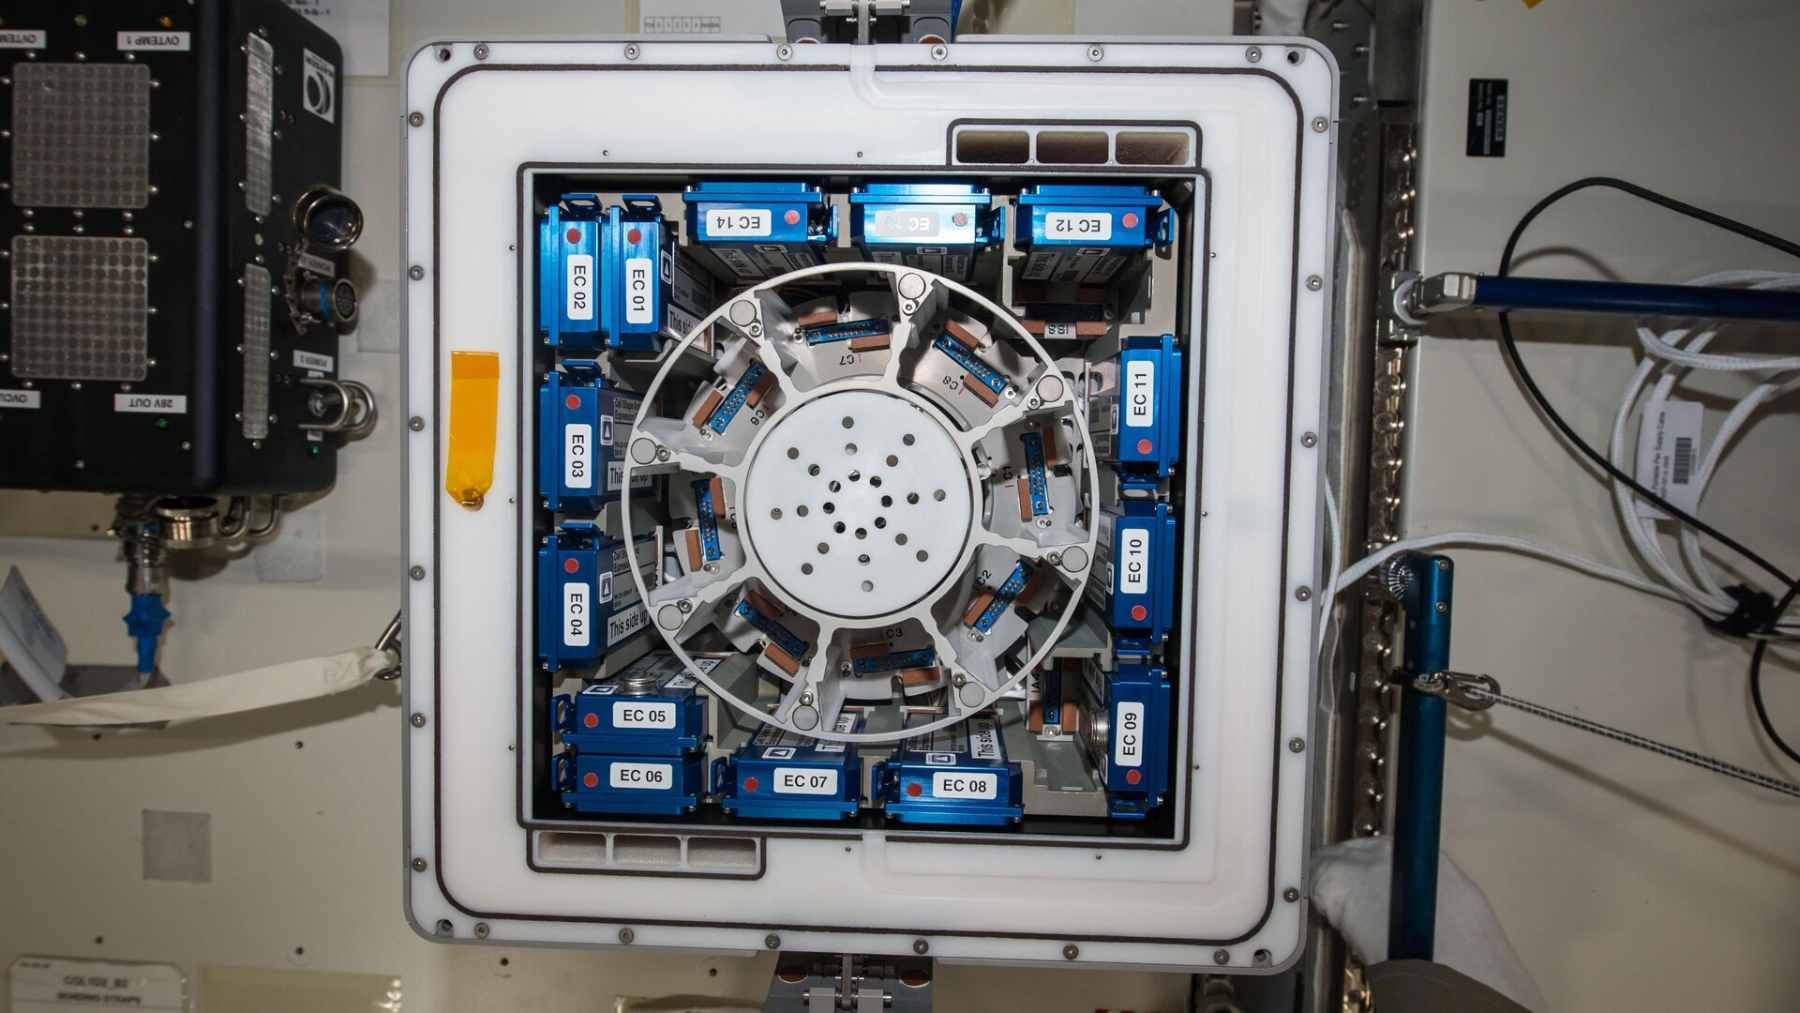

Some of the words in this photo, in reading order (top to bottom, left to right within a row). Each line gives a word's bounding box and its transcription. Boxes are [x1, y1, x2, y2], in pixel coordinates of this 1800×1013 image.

[127, 36, 132, 45] 1
[135, 35, 180, 46] OVTEMP
[718, 217, 733, 228] 14
[740, 217, 760, 229] EC
[1057, 220, 1073, 232] 12
[1080, 220, 1100, 232] EC
[575, 266, 586, 286] EC
[633, 270, 645, 290] EC
[574, 292, 586, 310] 02
[633, 296, 645, 312] 01
[839, 354, 855, 365] C7
[1134, 373, 1146, 388] 11
[128, 398, 152, 408] OUT
[153, 399, 174, 409] 28V
[1134, 395, 1146, 415] EC
[572, 435, 584, 455] EC
[572, 461, 584, 478] 03
[1130, 539, 1142, 556] 10
[1129, 562, 1142, 583] EC
[571, 594, 583, 614] EC
[571, 620, 583, 636] 04
[609, 621, 625, 639] This
[626, 612, 639, 632] side
[624, 709, 644, 722] EC
[649, 710, 666, 722] 05
[1124, 713, 1136, 730] 09
[1123, 735, 1136, 755] EC
[621, 769, 641, 782] EC
[646, 770, 662, 783] 06
[785, 775, 805, 787] EC
[810, 776, 827, 788] 07
[944, 780, 964, 792] EC
[970, 780, 987, 792] 08
